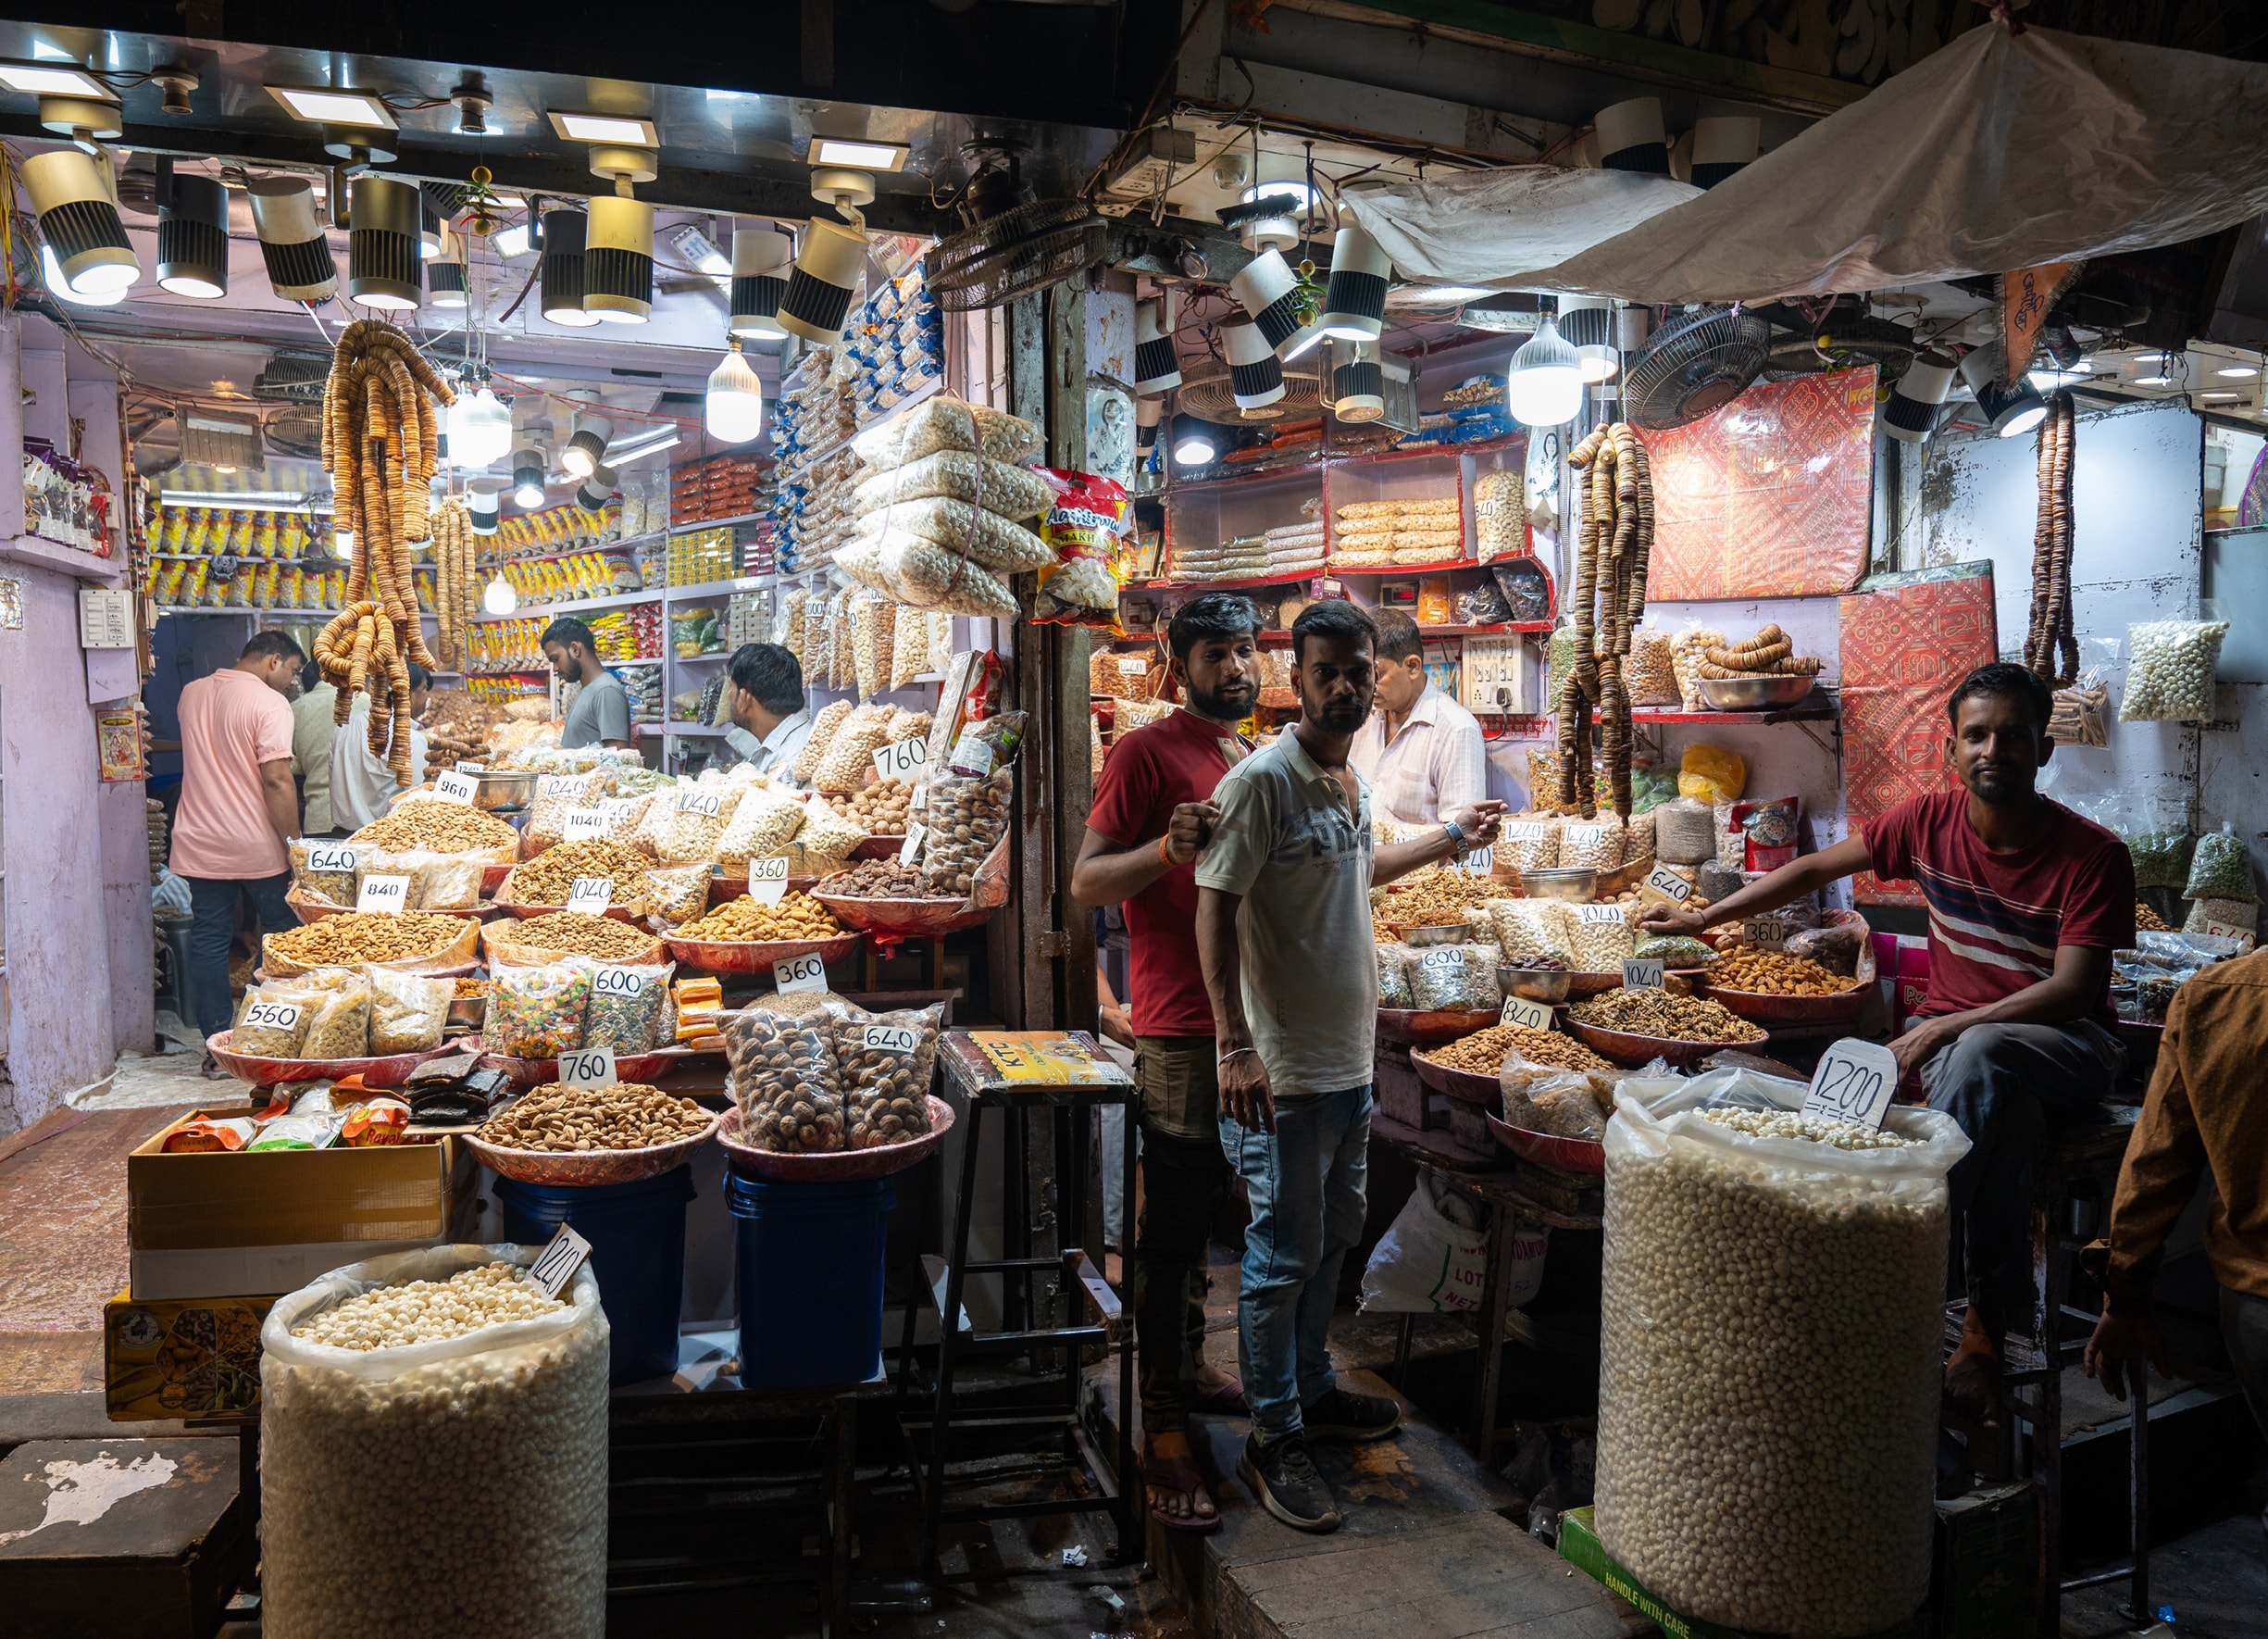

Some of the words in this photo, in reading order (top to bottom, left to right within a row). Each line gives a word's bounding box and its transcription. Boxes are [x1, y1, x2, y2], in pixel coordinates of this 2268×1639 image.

[877, 738, 927, 775] 760
[441, 780, 468, 798] 960
[547, 780, 585, 796] 1240
[678, 793, 720, 814] 1040
[570, 815, 603, 827] 1040
[1507, 824, 1542, 840] 1240
[1566, 824, 1600, 844] 1240
[311, 850, 355, 869] 640
[754, 859, 785, 879] 360
[368, 883, 399, 895] 840
[569, 880, 613, 900] 1040
[1651, 870, 1690, 901] 640
[1581, 906, 1621, 923] 1040
[1747, 922, 1782, 943] 360
[1424, 949, 1462, 967] 600
[778, 958, 822, 983] 360
[1627, 966, 1664, 987] 1040
[596, 969, 642, 994] 600
[247, 1004, 296, 1026] 560
[1502, 1000, 1541, 1029] 840
[866, 1027, 913, 1049] 640
[987, 1041, 1025, 1068] KTC
[562, 1054, 606, 1082] 760
[1814, 1056, 1883, 1118] 1200
[366, 1129, 401, 1145] Royal
[531, 1232, 579, 1295] 1240
[1455, 1267, 1484, 1288] LOT
[1445, 1291, 1478, 1310] NET
[1605, 1571, 1639, 1606] HANDLE
[1639, 1595, 1664, 1622] WITH
[1664, 1611, 1690, 1639] CARE
